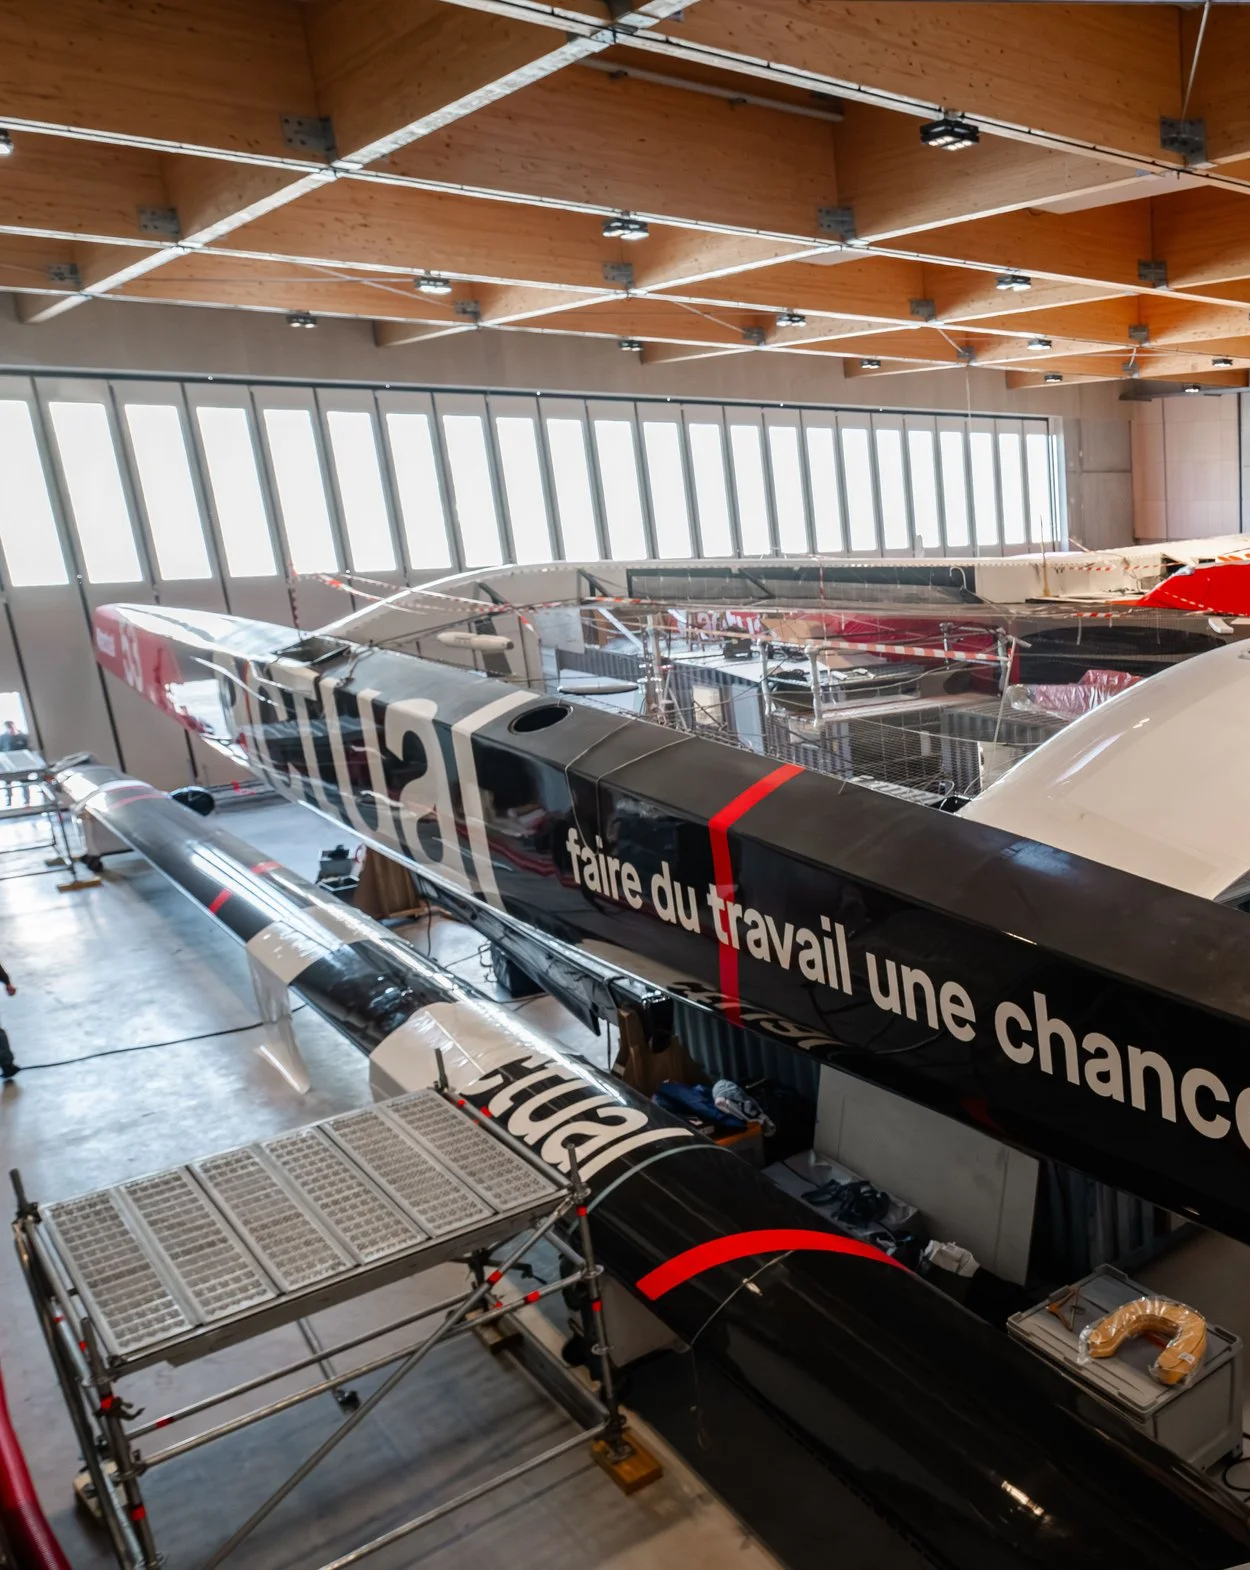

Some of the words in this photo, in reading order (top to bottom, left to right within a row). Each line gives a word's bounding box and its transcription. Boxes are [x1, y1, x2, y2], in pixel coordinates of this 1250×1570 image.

[566, 827, 643, 909] faire
[651, 860, 701, 934] du
[706, 883, 853, 996] travail
[865, 952, 977, 1042] une
